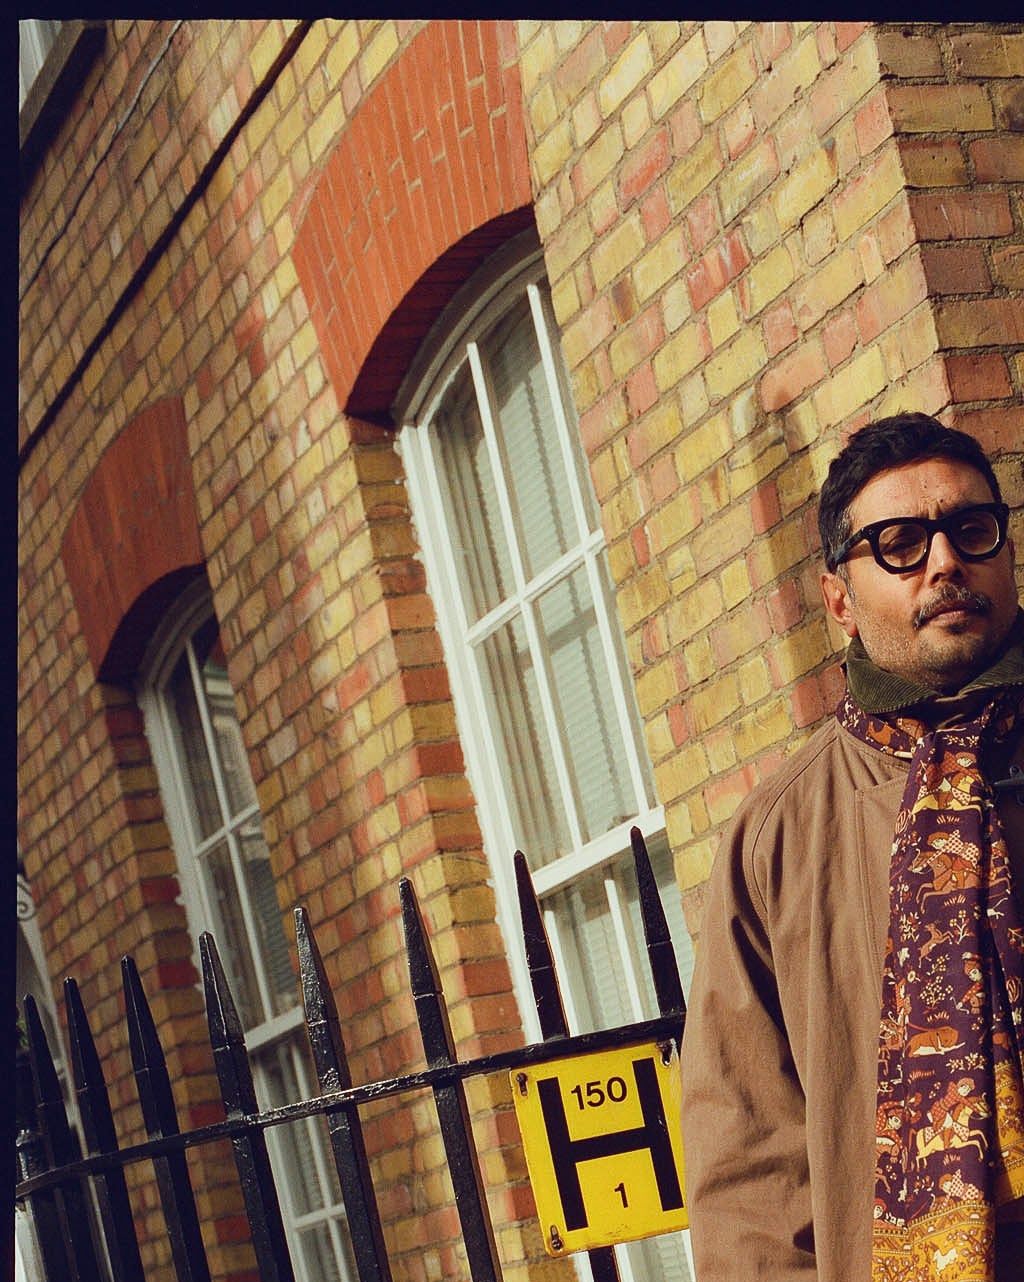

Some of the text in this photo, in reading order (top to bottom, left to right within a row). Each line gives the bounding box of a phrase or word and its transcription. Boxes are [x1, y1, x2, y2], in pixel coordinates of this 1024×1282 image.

[571, 1077, 628, 1110] 150
[536, 1057, 685, 1232] H
[614, 1182, 629, 1209] 1
